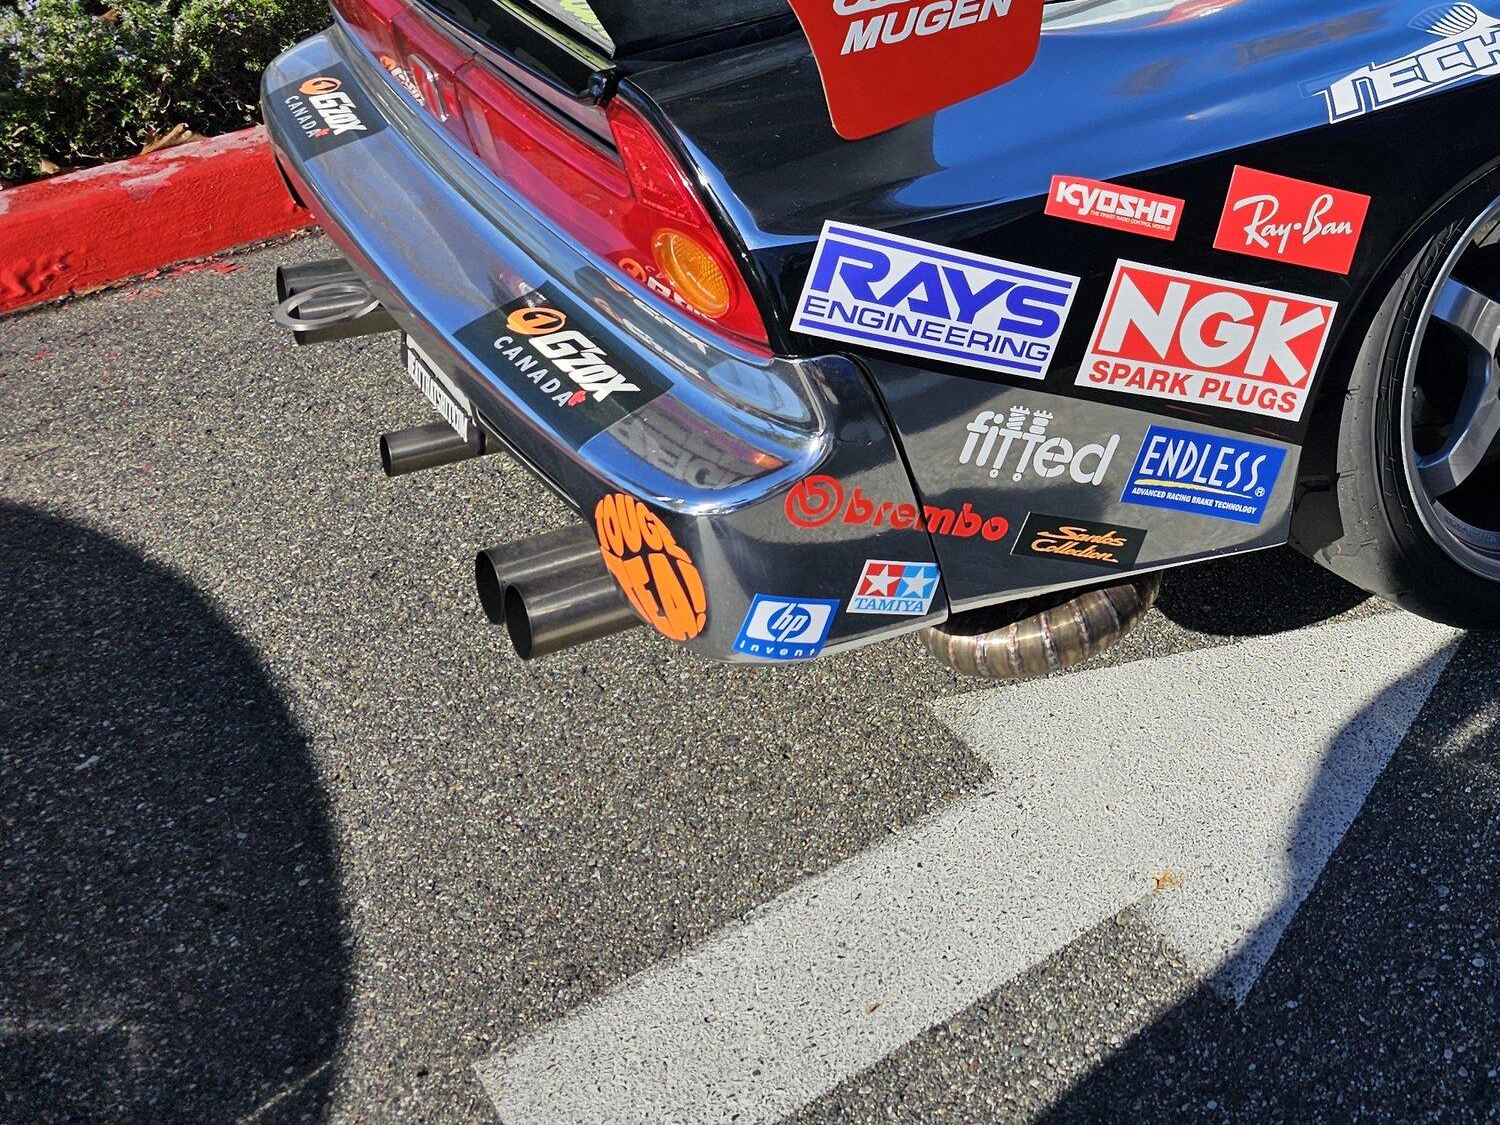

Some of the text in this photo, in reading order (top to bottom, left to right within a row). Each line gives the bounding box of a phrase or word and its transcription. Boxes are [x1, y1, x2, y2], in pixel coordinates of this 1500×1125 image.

[284, 95, 318, 139] CANADA
[1055, 180, 1177, 226] KYOSHO
[808, 238, 1070, 340] RAYS
[802, 296, 1051, 363] ENGINEERING
[1098, 271, 1326, 387] NGK
[493, 335, 575, 408] CANADA
[1088, 359, 1299, 415] SPARK PLUGS
[1139, 435, 1267, 493] ENDLESS
[843, 488, 1009, 542] brembo
[1131, 487, 1258, 515] ADVANCED RACING BRAKE TECHNOLOGY
[774, 603, 806, 643] hp
[854, 596, 926, 614] TAMIYA
[739, 638, 817, 659] invent
